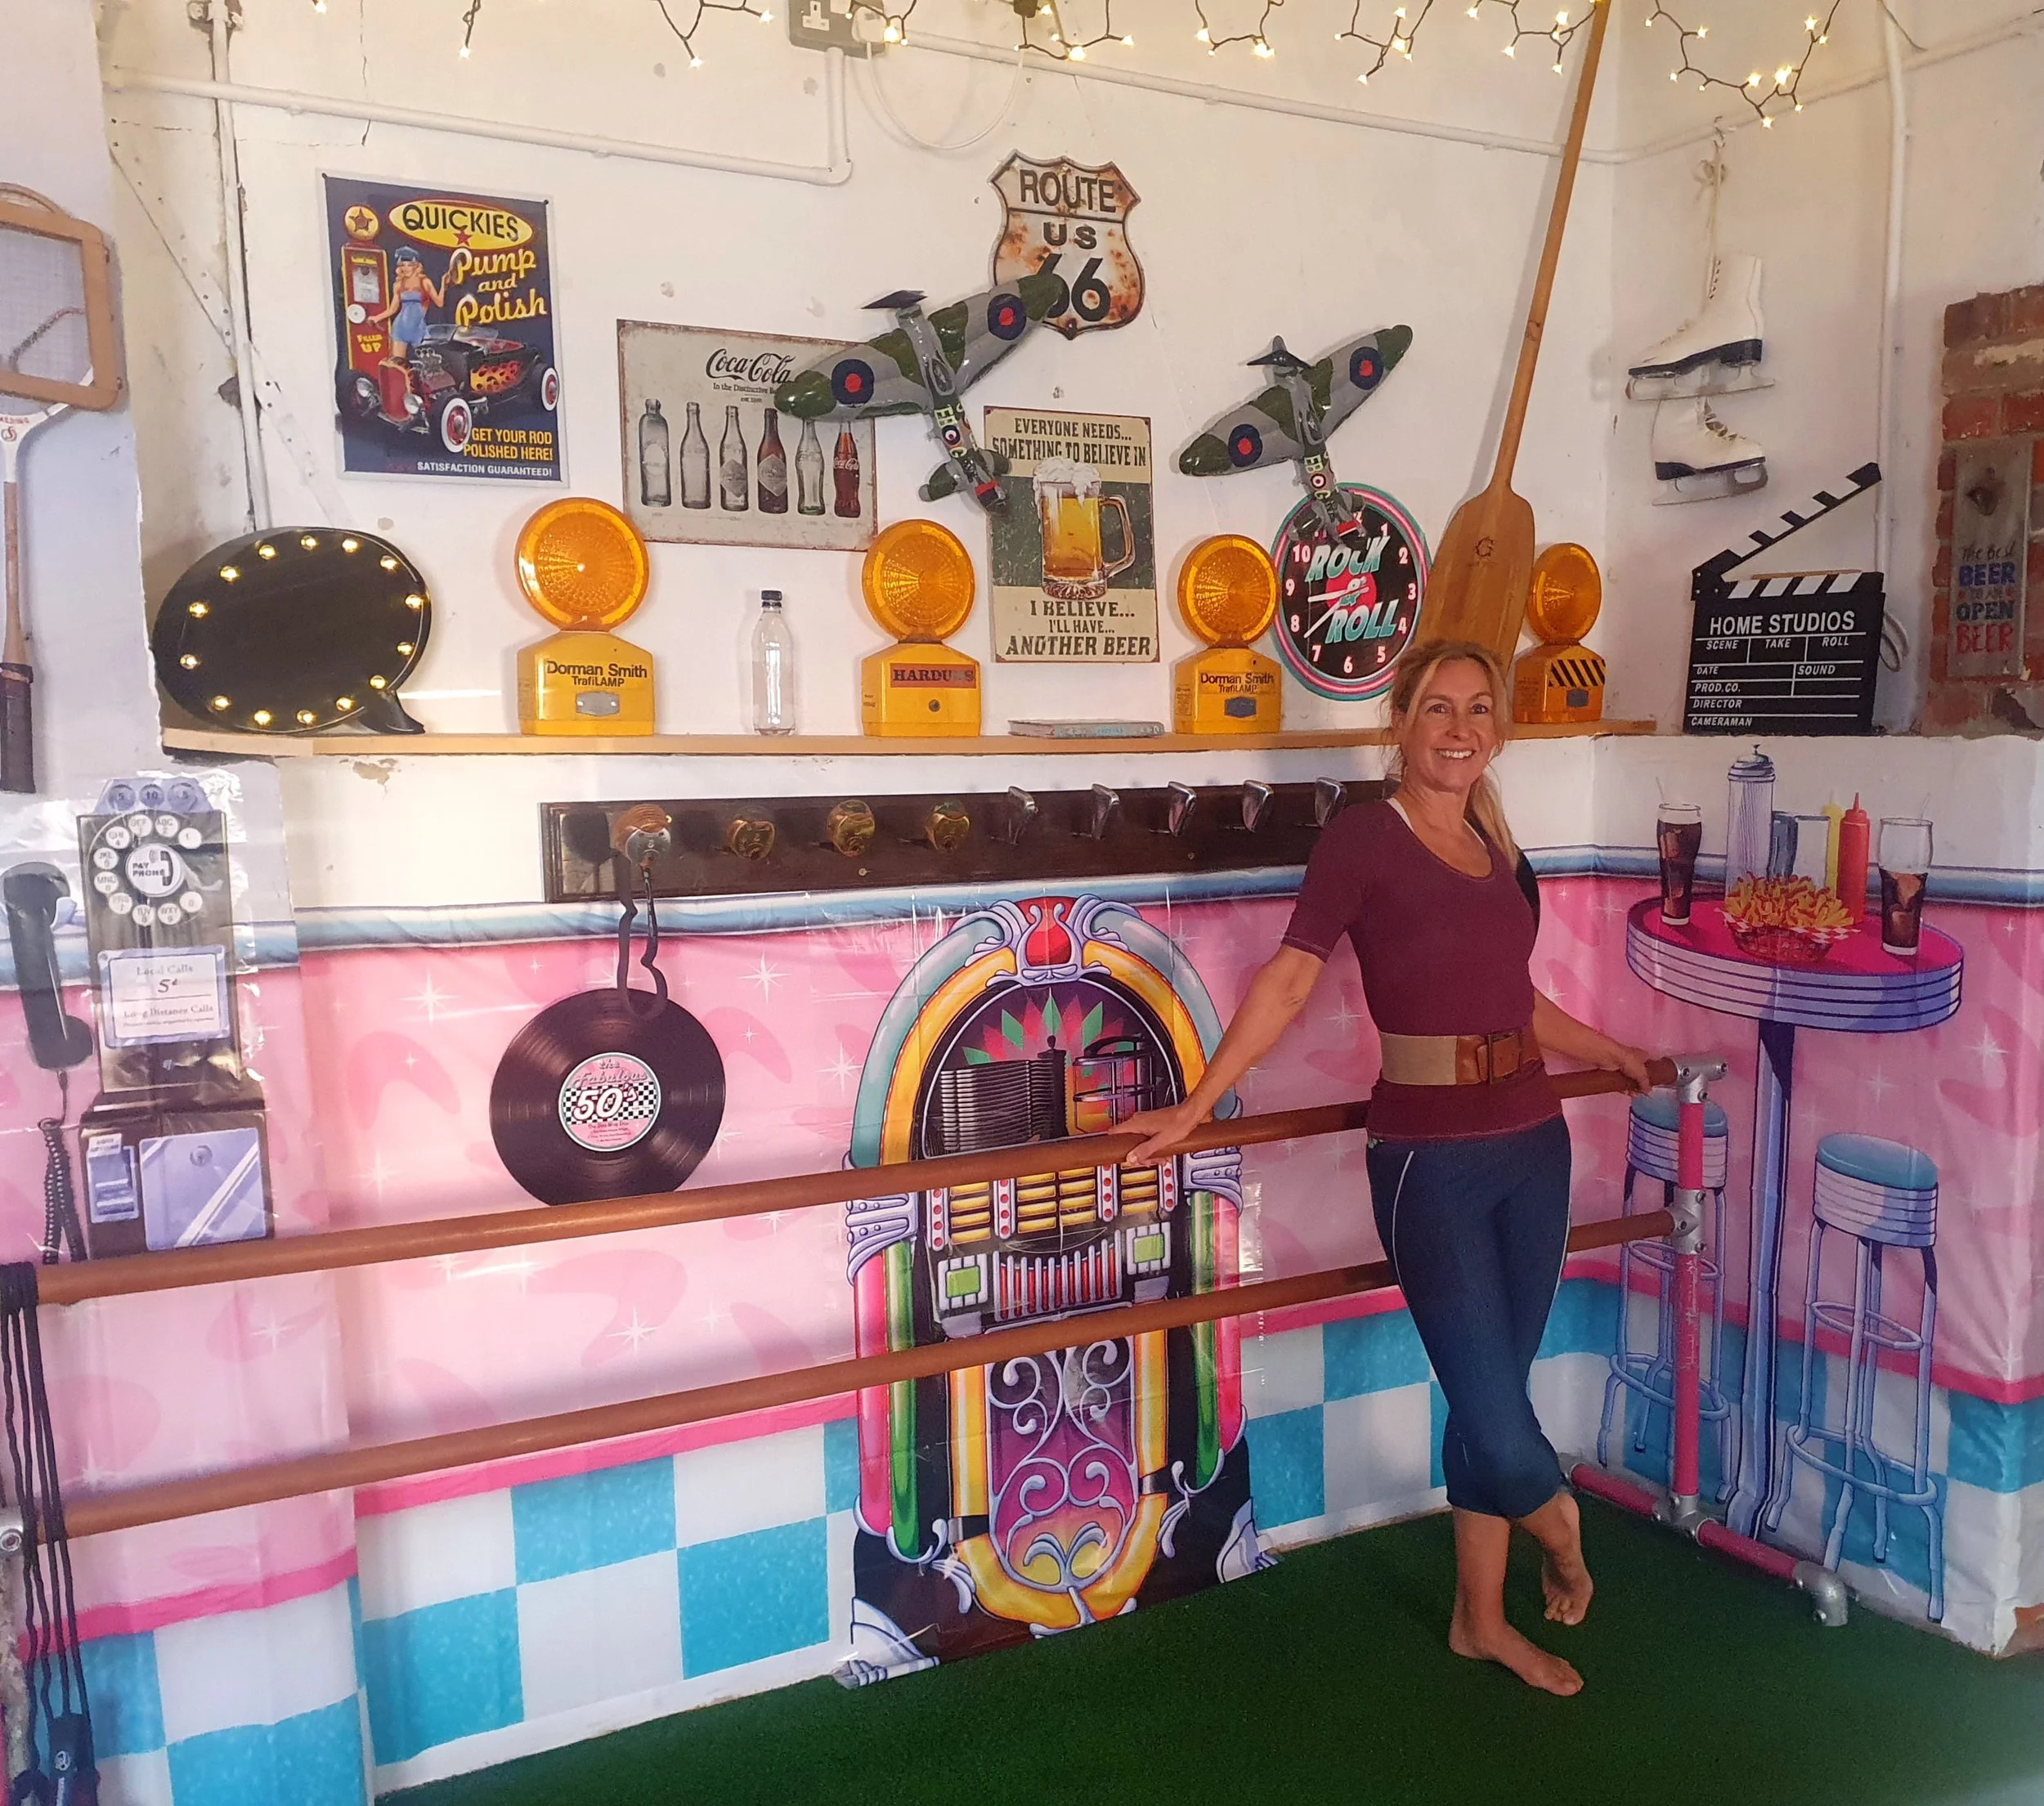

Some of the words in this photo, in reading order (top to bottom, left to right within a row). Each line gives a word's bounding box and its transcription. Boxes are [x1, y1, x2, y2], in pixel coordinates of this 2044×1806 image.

[1020, 169, 1116, 213] ROUTE
[402, 204, 519, 242] QUICKIES
[1043, 222, 1097, 249] US
[450, 248, 536, 284] Pump
[477, 273, 518, 293] and
[455, 288, 547, 332] Polish
[472, 428, 492, 441] GET
[495, 428, 527, 443] YOUR
[529, 430, 552, 445] ROD
[1014, 417, 1079, 437] EVERYONE
[1083, 422, 1132, 441] NEEDS...
[464, 443, 518, 459] POLISHED
[521, 446, 553, 461] HERE!
[993, 437, 1062, 461] SOMETHING
[1065, 441, 1080, 462] TO
[1083, 444, 1132, 466] BELIEVE
[1134, 446, 1146, 467] IN
[417, 461, 485, 474] SATISFACTION
[487, 464, 552, 477] GUARANTEED!
[1293, 544, 1311, 563] 10
[1305, 536, 1390, 582] ROCK
[1399, 547, 1408, 564] 2
[1959, 562, 2015, 587] BEER
[1285, 579, 1295, 596] 9
[1408, 583, 1416, 600] 3
[1030, 600, 1038, 616] I
[1043, 600, 1135, 618] BELIEVE...
[1956, 600, 2014, 621] OPEN
[1049, 619, 1070, 633] I'LL
[1290, 615, 1300, 632] 8
[1325, 599, 1399, 643] ROLL
[1398, 617, 1407, 634] 4
[1710, 616, 1763, 635] HOME
[1768, 611, 1855, 633] STUDIOS
[1005, 635, 1096, 656] ANOTHER
[1103, 637, 1150, 656] BEER
[1706, 640, 1739, 650] SCENE
[1765, 638, 1791, 648] TAKE
[1822, 636, 1849, 647] ROLL
[1956, 622, 2014, 652] BEER
[1311, 645, 1321, 662] 7
[1377, 646, 1386, 663] 5
[547, 661, 603, 675] Dorman
[608, 663, 648, 678] Smith
[1343, 657, 1353, 674] 6
[1697, 666, 1719, 675] DATE
[1798, 665, 1836, 675] SOUND
[1201, 673, 1241, 683] Dorman
[1245, 672, 1274, 683] Smith
[1692, 699, 1742, 709] DIRECTOR
[1691, 717, 1752, 727] CAMERAMAN
[167, 964, 193, 975] Calls
[191, 1005, 213, 1014] Calls
[573, 1082, 638, 1121] 50's
